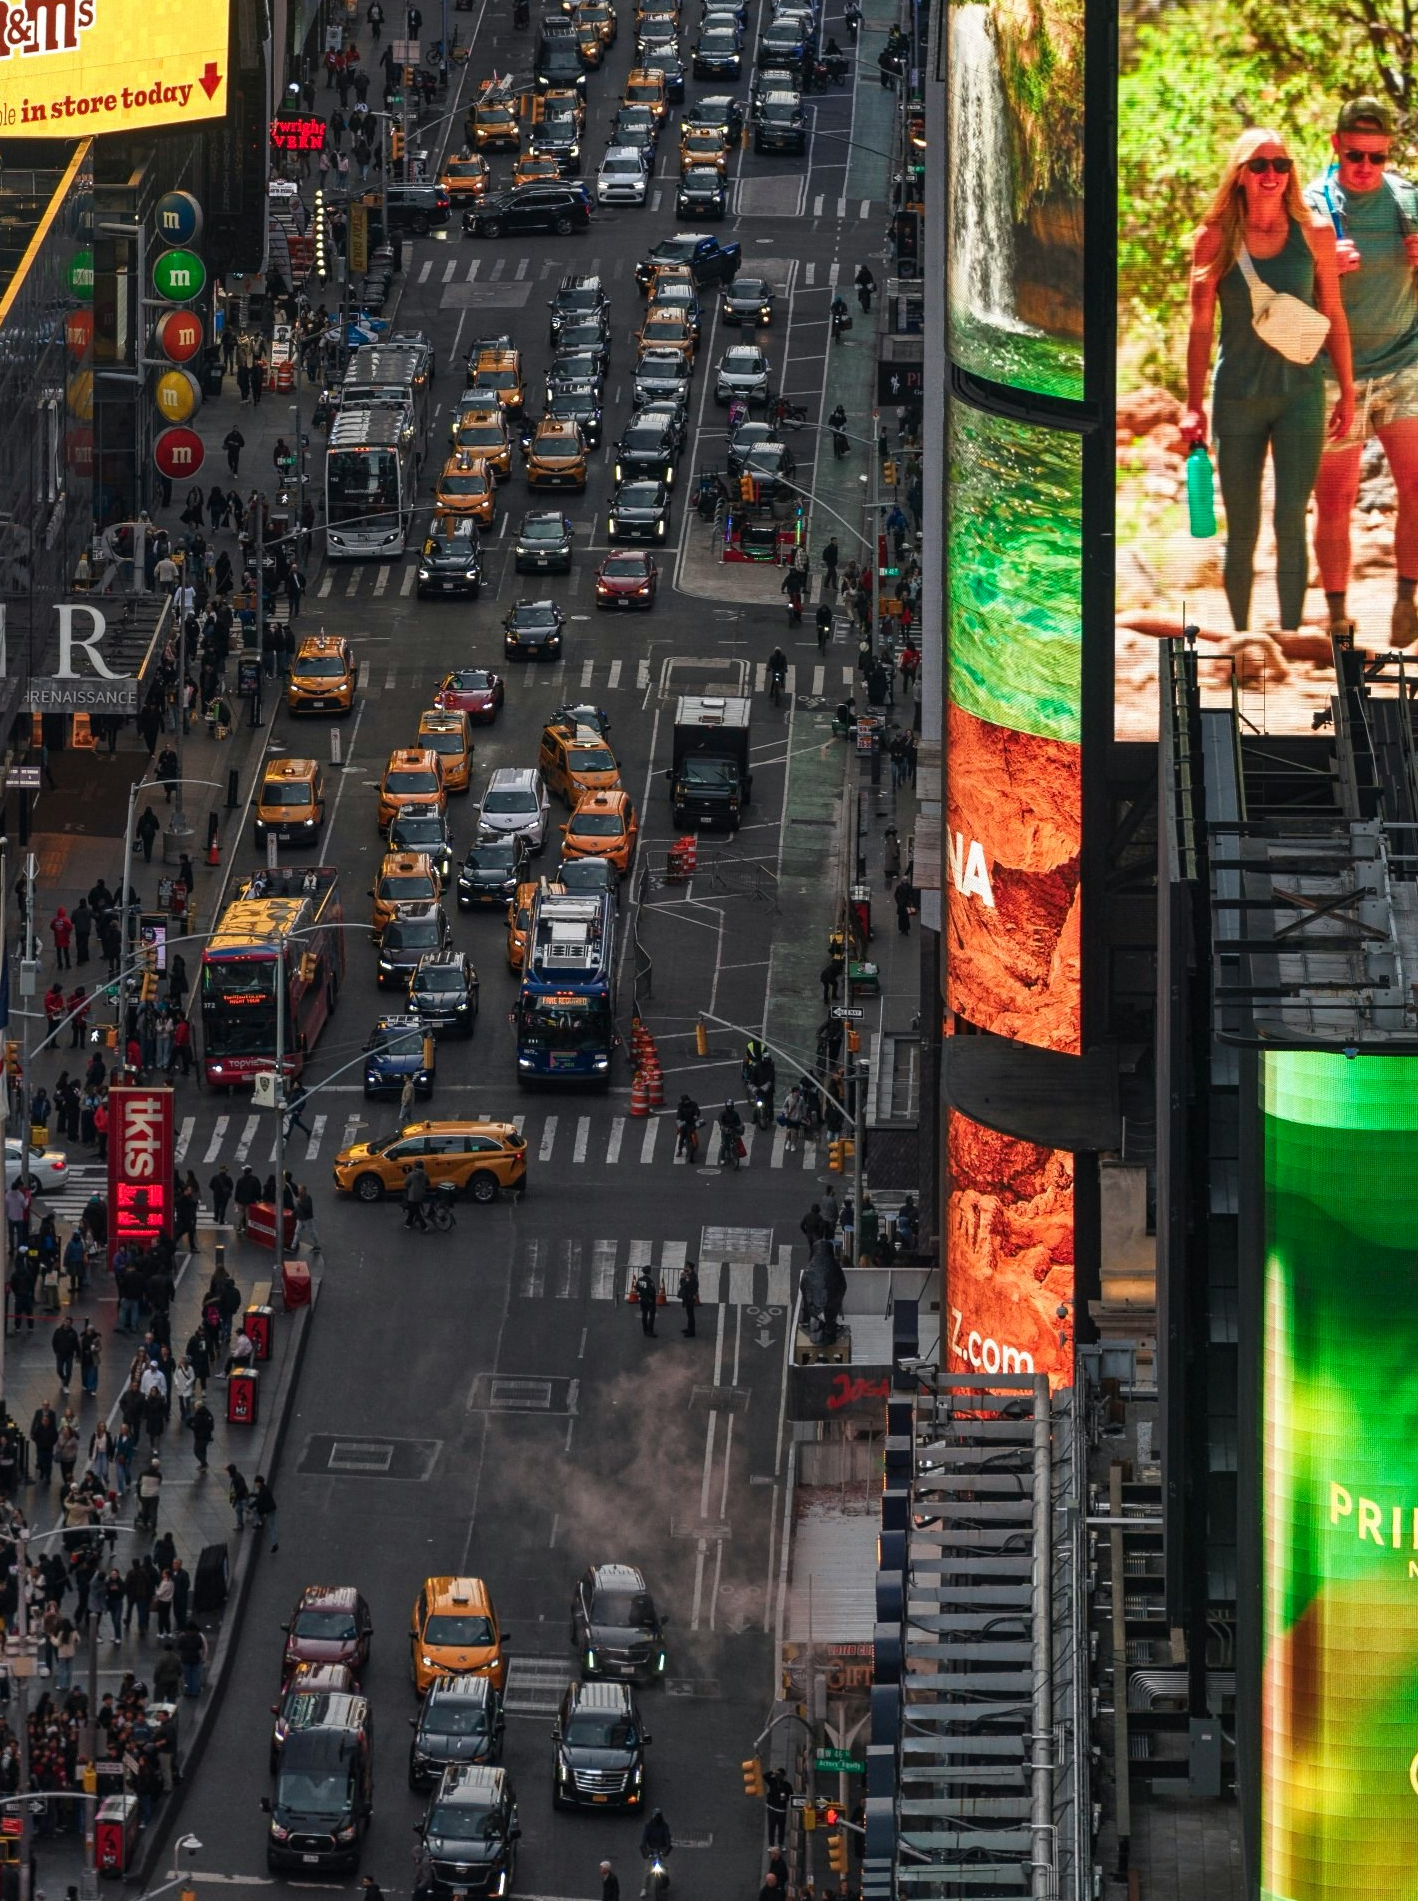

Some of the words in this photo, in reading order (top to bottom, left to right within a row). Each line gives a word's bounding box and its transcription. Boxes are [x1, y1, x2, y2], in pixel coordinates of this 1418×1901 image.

[21, 98, 47, 124] in
[50, 93, 117, 120] store
[119, 82, 194, 112] today
[271, 135, 324, 150] VERN
[163, 210, 180, 229] m
[170, 269, 190, 286] m
[179, 328, 195, 344] m
[163, 389, 179, 407] m
[172, 446, 191, 464] m
[52, 604, 131, 680] R
[29, 691, 136, 704] RENAISSANCE
[124, 1098, 164, 1177] tkts
[951, 1309, 1034, 1377] Z.com
[818, 1760, 840, 1769] Actors'
[842, 1760, 861, 1771] Equity
